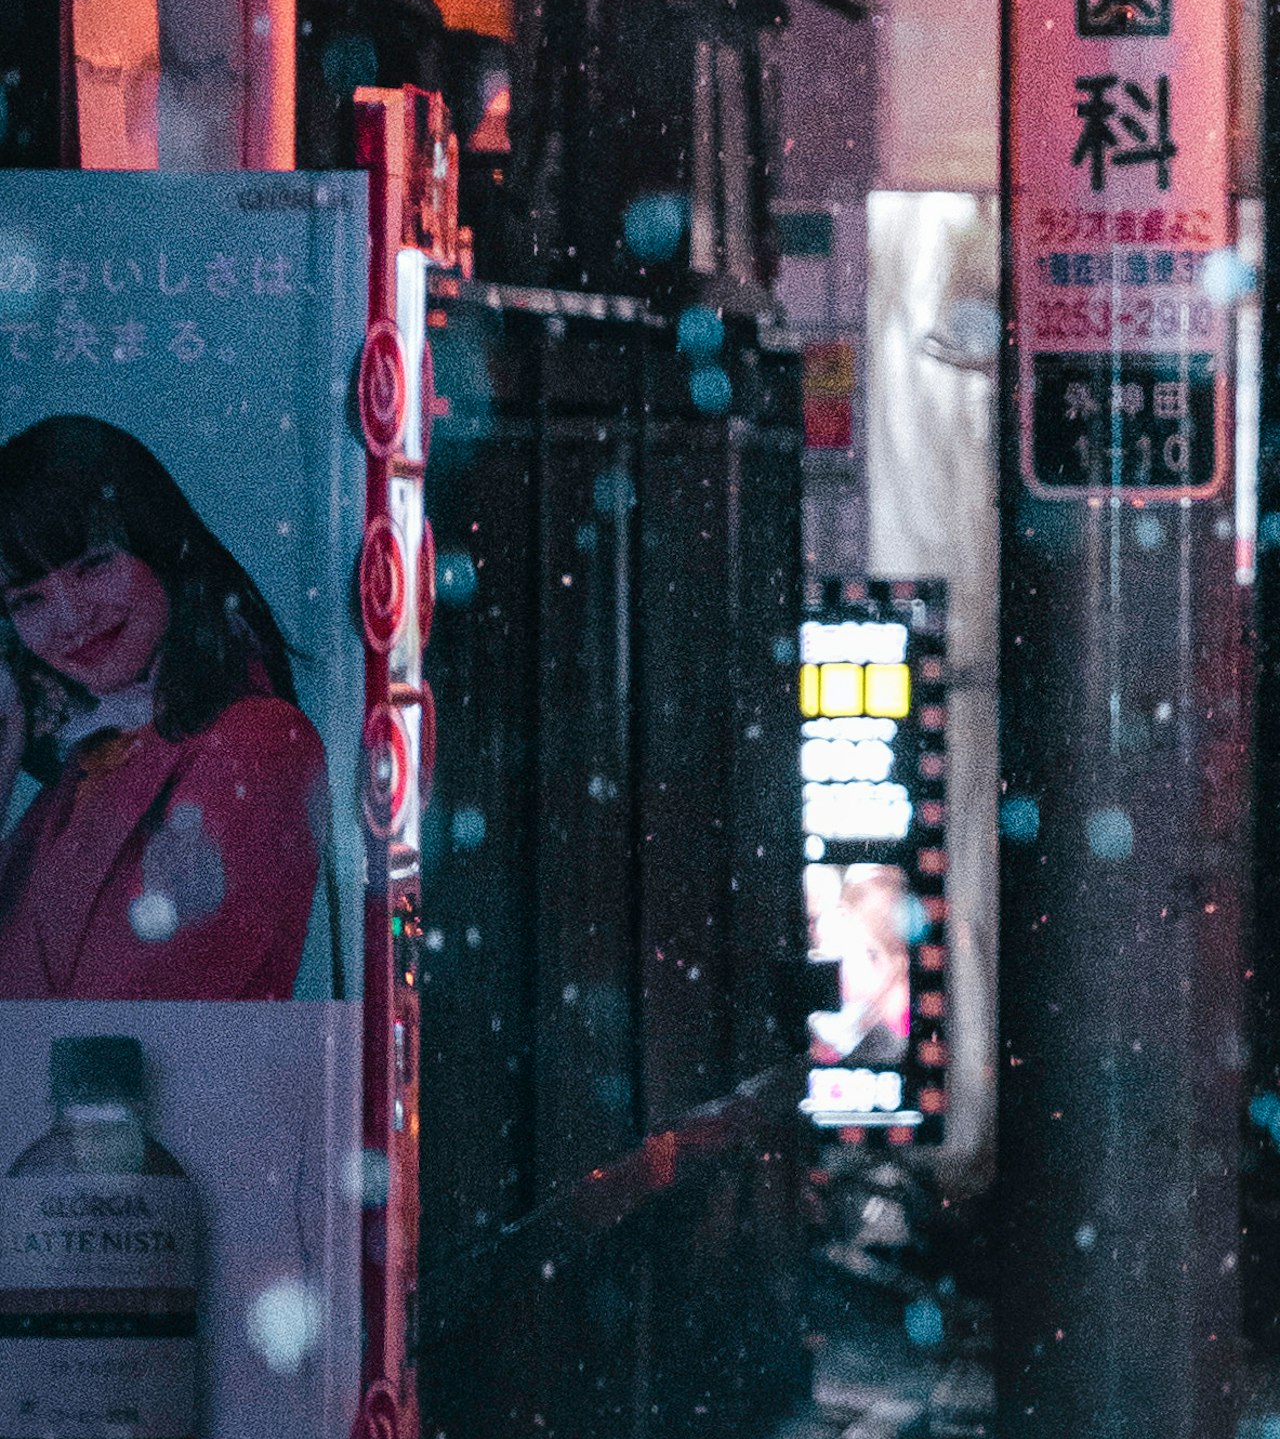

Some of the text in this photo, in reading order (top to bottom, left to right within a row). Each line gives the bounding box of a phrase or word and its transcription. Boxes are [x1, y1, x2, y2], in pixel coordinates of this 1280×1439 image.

[1063, 380, 1190, 421] 外神田
[102, 1228, 177, 1254] NISTA
